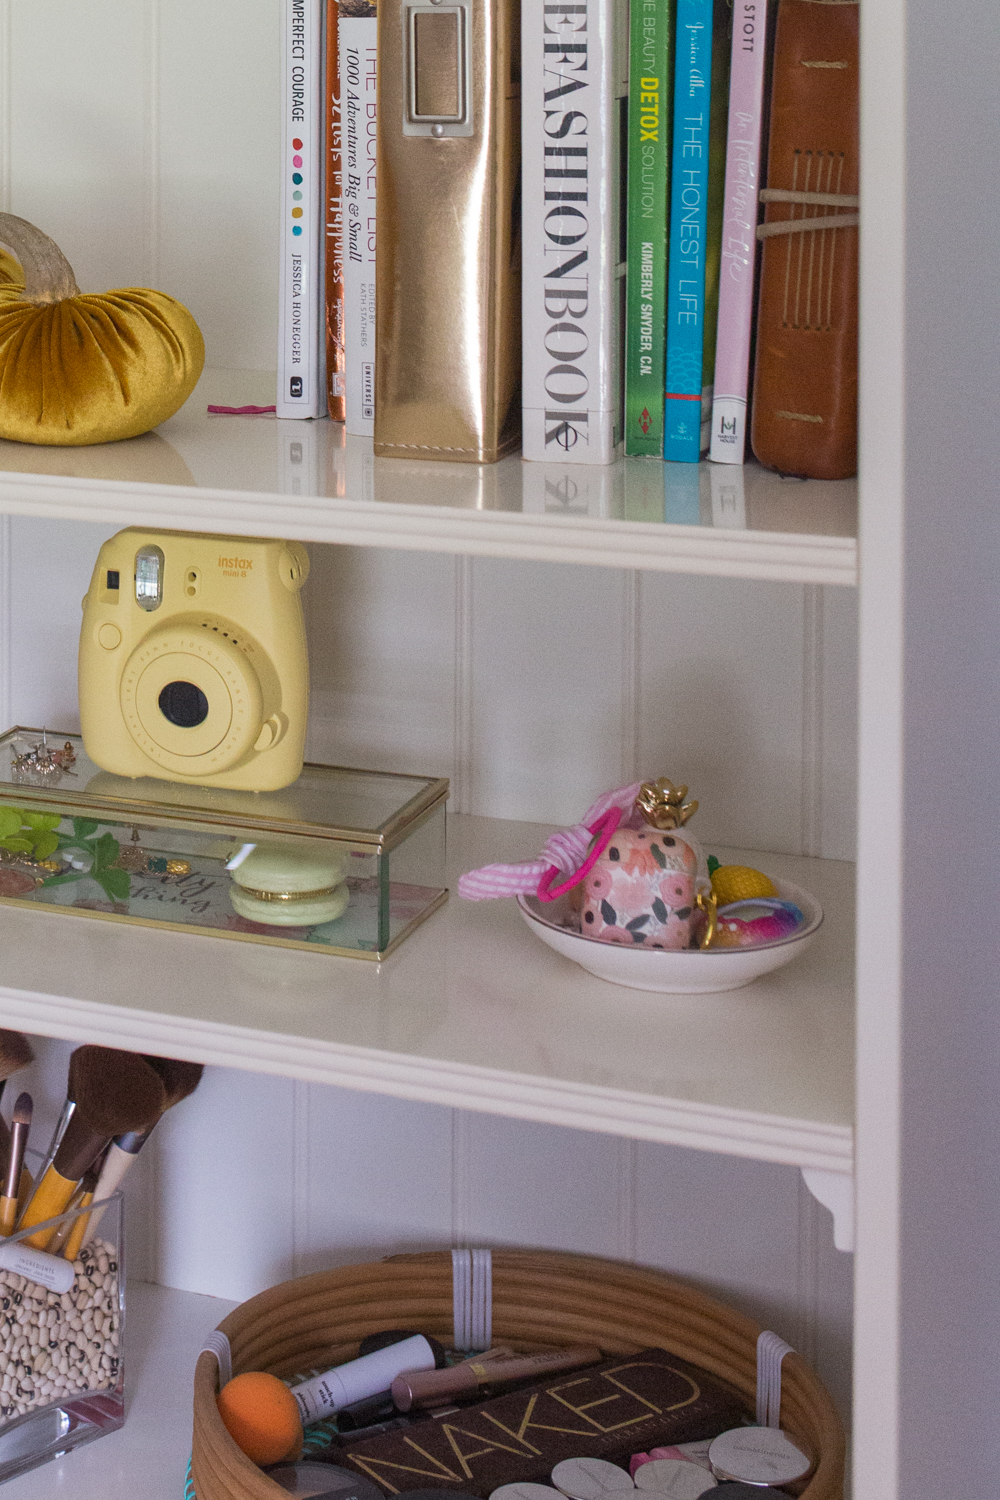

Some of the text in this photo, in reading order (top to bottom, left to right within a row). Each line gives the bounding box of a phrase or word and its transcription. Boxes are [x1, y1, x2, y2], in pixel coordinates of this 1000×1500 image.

[642, 17, 656, 74] BEAUTY
[743, 4, 756, 53] STOTT
[685, 21, 705, 98] Jessica Alba
[291, 66, 305, 122] COURAGE
[639, 77, 659, 142] DETOX
[345, 47, 363, 263] 1000 Adventures Big & Small
[640, 145, 655, 218] SOLUTION
[727, 139, 756, 230] Intentional
[677, 112, 703, 326] THE HONEST LIFE
[722, 232, 750, 283] Life
[291, 254, 302, 365] JESSICA HONEGGER
[360, 306, 368, 347] STATHERS
[368, 283, 376, 314] EDITED
[639, 242, 653, 377] KIMBERLY SNYDER, C.N.
[364, 366, 372, 403] UNIVERSE
[217, 555, 253, 570] instax
[240, 570, 247, 578] 8
[346, 1362, 701, 1494] NAKED
